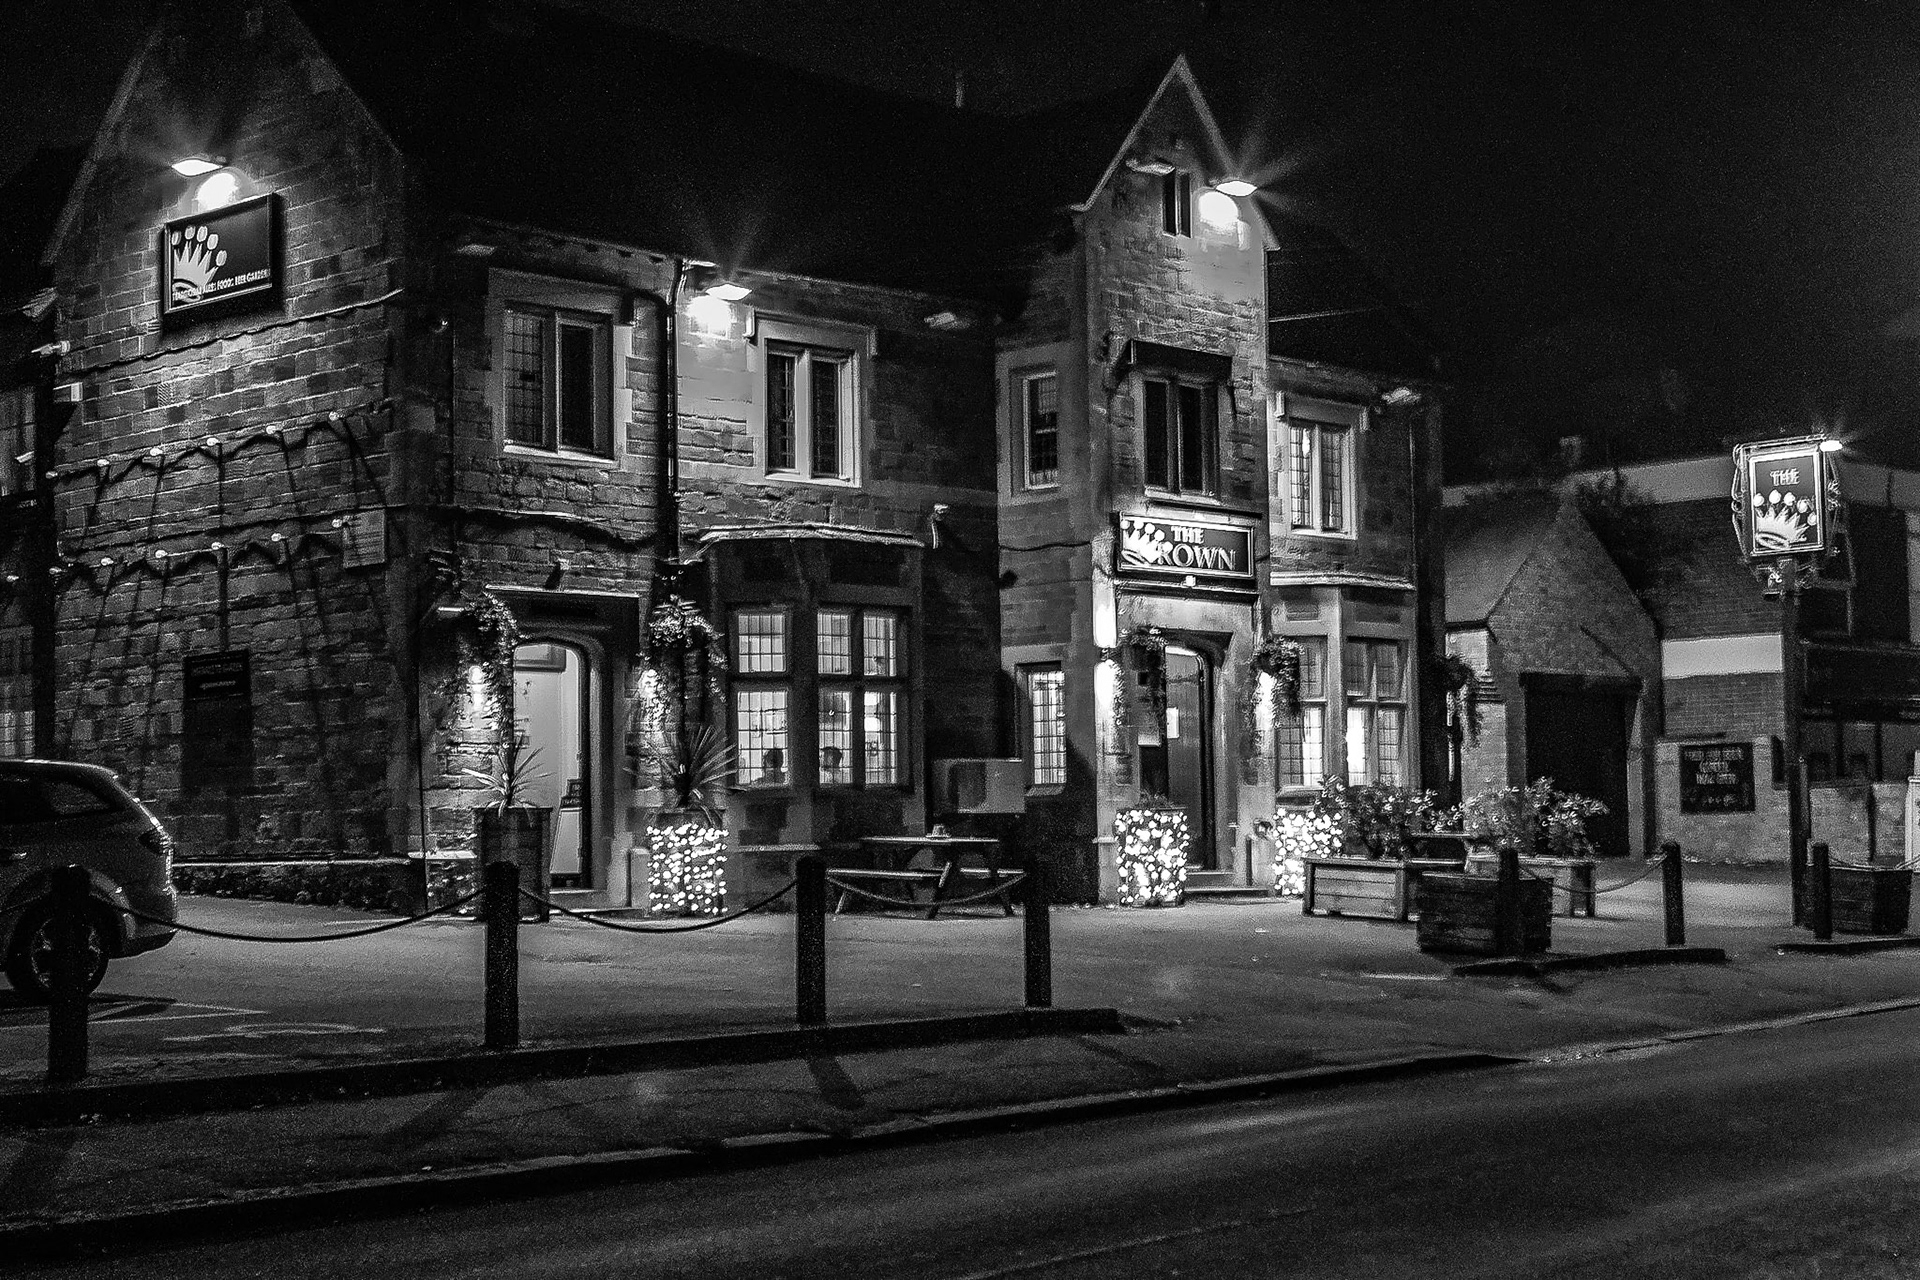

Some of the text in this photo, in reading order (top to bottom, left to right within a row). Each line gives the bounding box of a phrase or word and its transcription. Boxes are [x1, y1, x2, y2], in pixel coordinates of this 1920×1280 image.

[1769, 468, 1800, 487] THE
[1171, 525, 1205, 544] THE
[1155, 541, 1237, 571] ROWN
